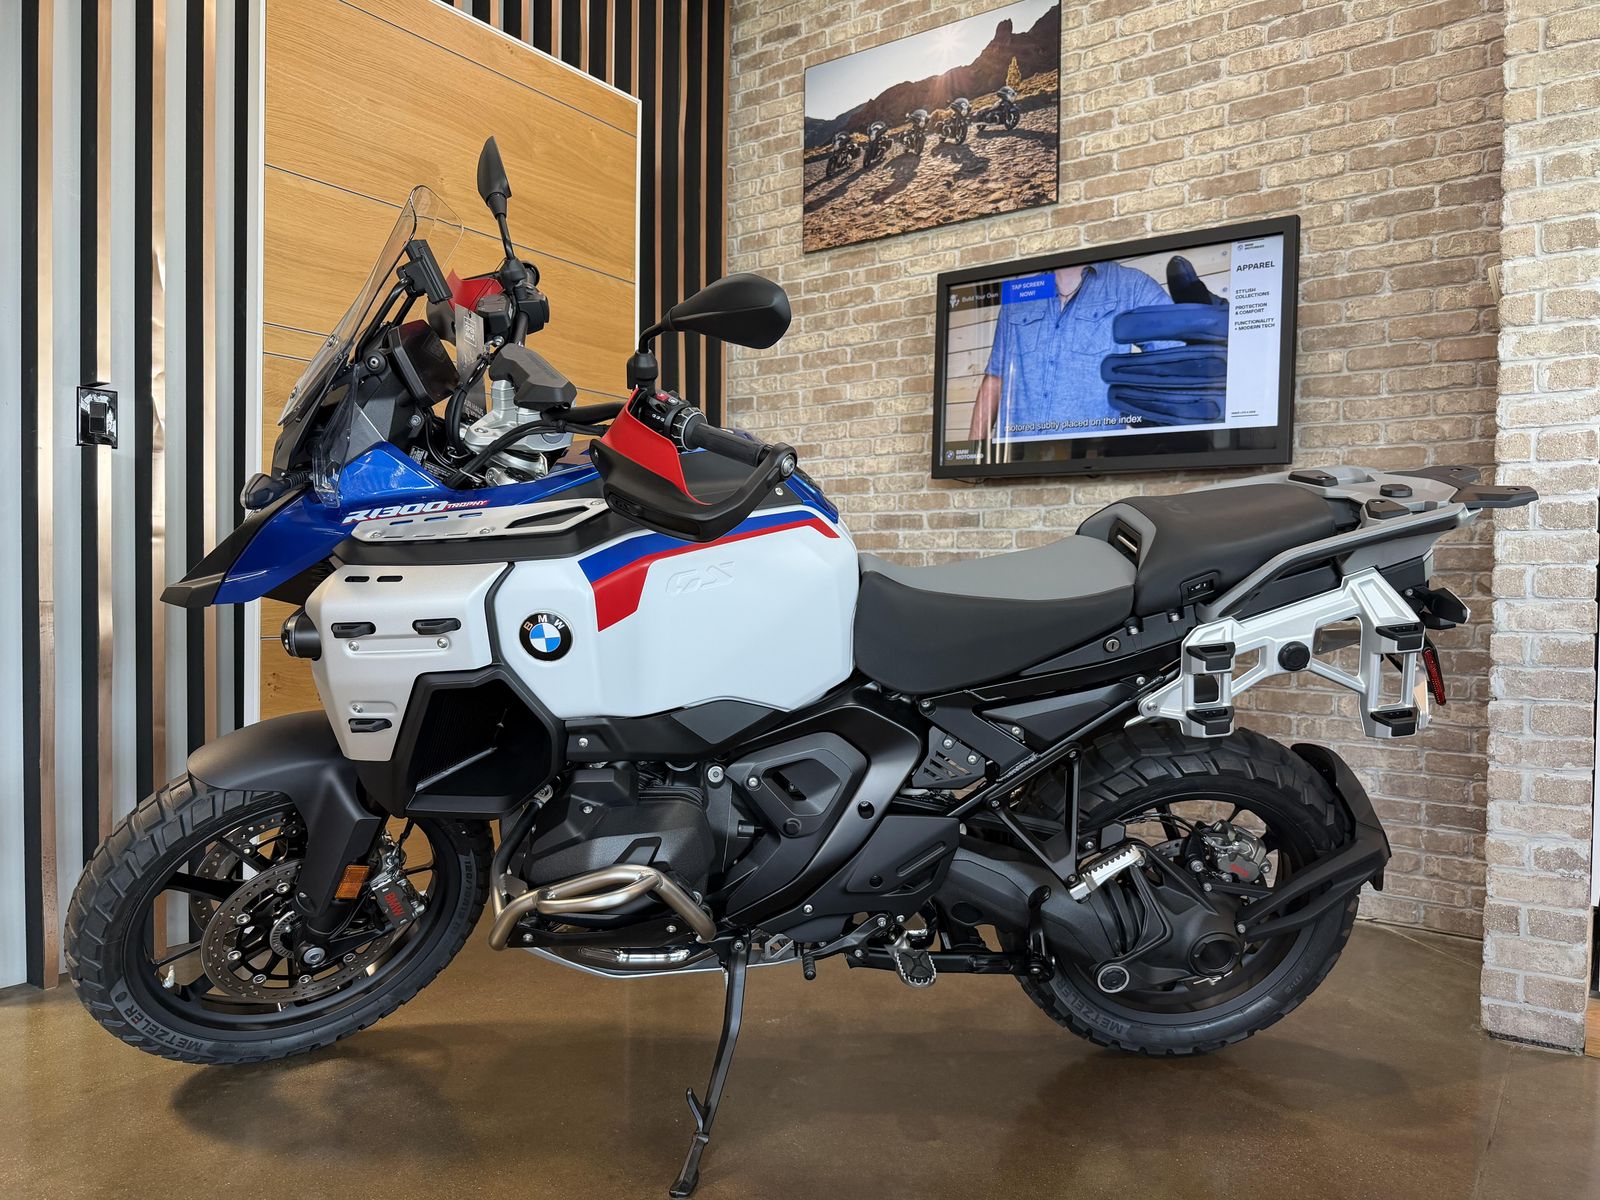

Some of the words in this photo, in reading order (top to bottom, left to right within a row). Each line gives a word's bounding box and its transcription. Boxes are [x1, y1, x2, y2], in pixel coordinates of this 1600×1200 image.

[1236, 260, 1275, 272] APPAREL
[1022, 280, 1045, 289] SCREEN
[1019, 290, 1036, 298] NOW!
[1235, 290, 1271, 300] COLLECTIONS
[1234, 302, 1268, 310] PROTECTION
[1234, 317, 1275, 326] FUNCTIONALITY
[1036, 419, 1060, 431] subtly
[1061, 418, 1089, 431] placed
[1091, 418, 1101, 426] on
[1103, 416, 1117, 425] the
[1118, 414, 1143, 424] index
[447, 500, 488, 509] TROPHY
[523, 614, 566, 631] BMW
[123, 1004, 204, 1052] METZELER
